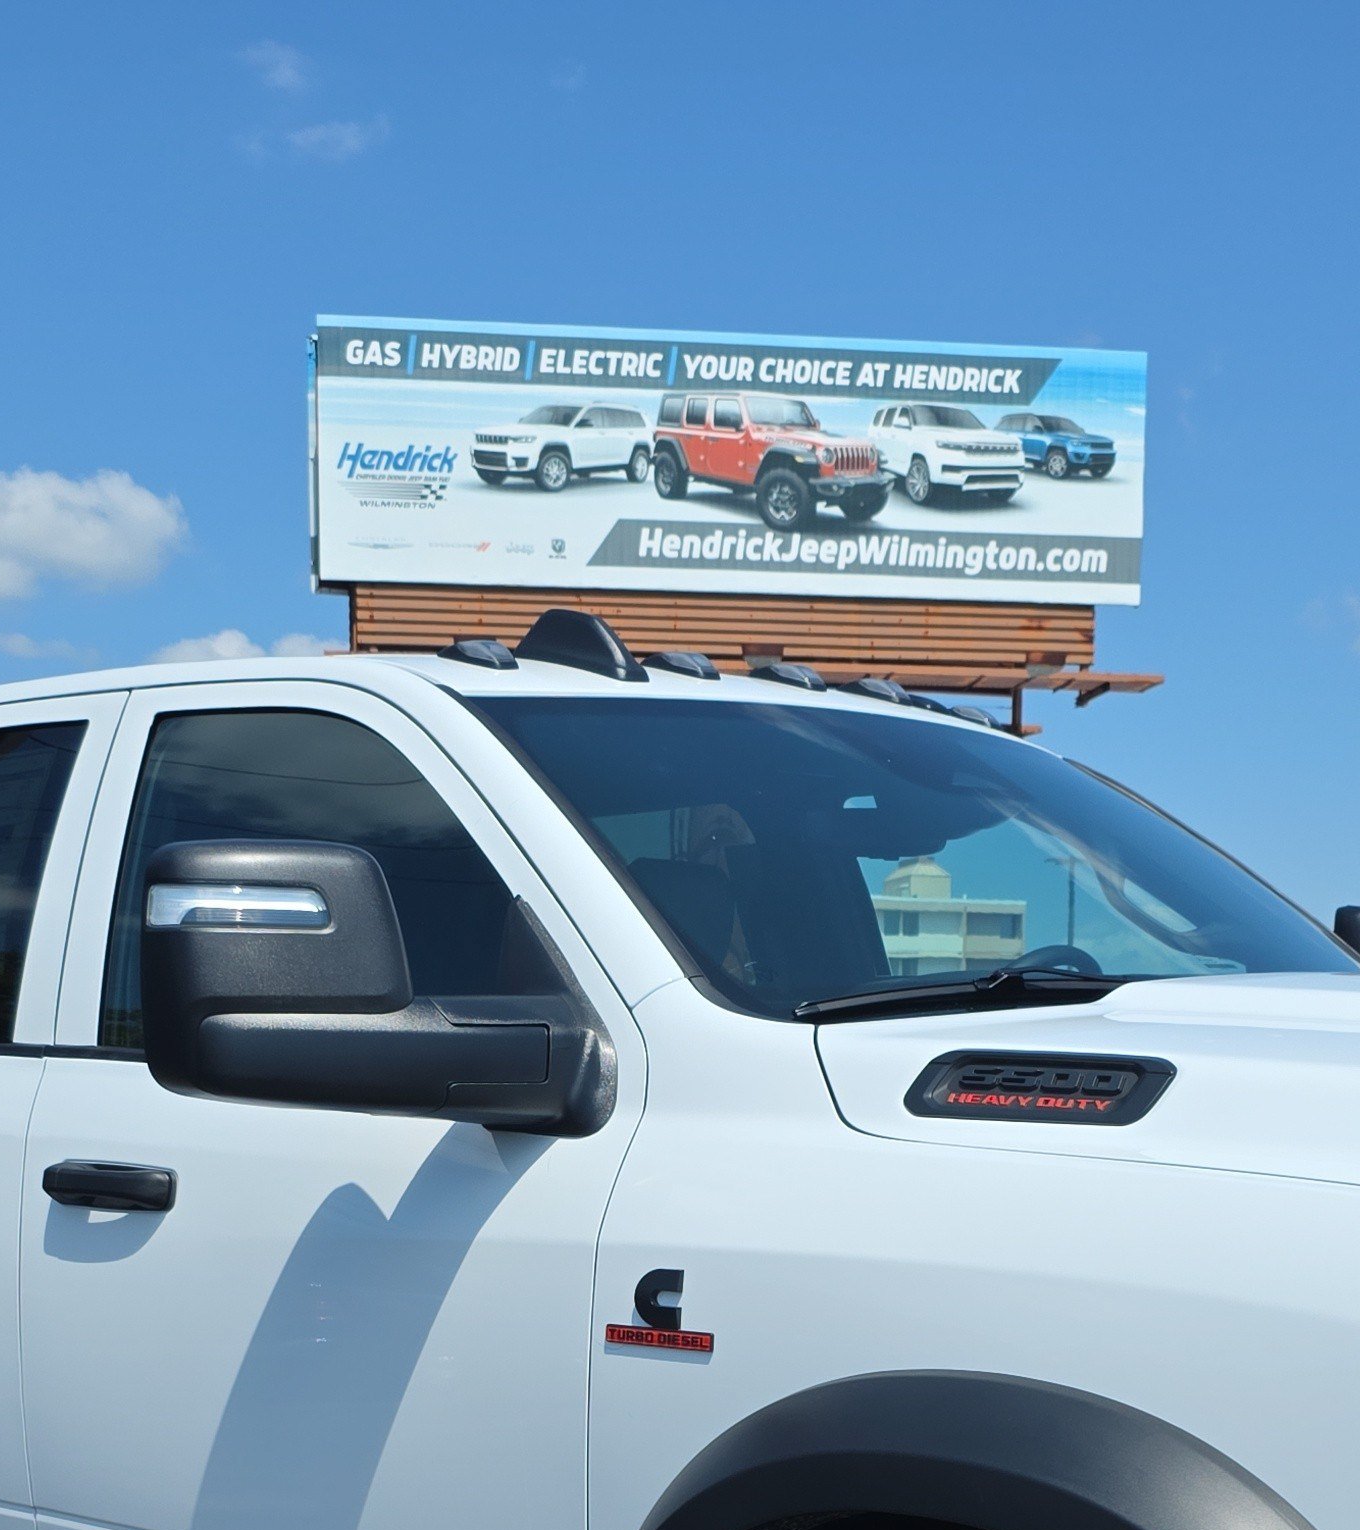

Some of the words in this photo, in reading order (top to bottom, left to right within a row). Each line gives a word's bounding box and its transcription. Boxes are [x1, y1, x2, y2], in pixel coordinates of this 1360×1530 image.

[345, 338, 402, 367] GAS
[421, 342, 520, 372] HYBRID
[539, 348, 664, 378] ELECTRIC
[683, 354, 752, 382] YOUR
[758, 357, 852, 387] CHOICE
[856, 362, 891, 388] AT
[893, 364, 1023, 394] HENDRICK
[337, 442, 458, 478] Hendrick
[638, 526, 1108, 575] HendrickJeepWilmington.com
[947, 1091, 1031, 1108] HEAVY
[1036, 1094, 1113, 1112] DUTY
[608, 1328, 654, 1343] TURBO
[657, 1332, 709, 1349] DIESEL
